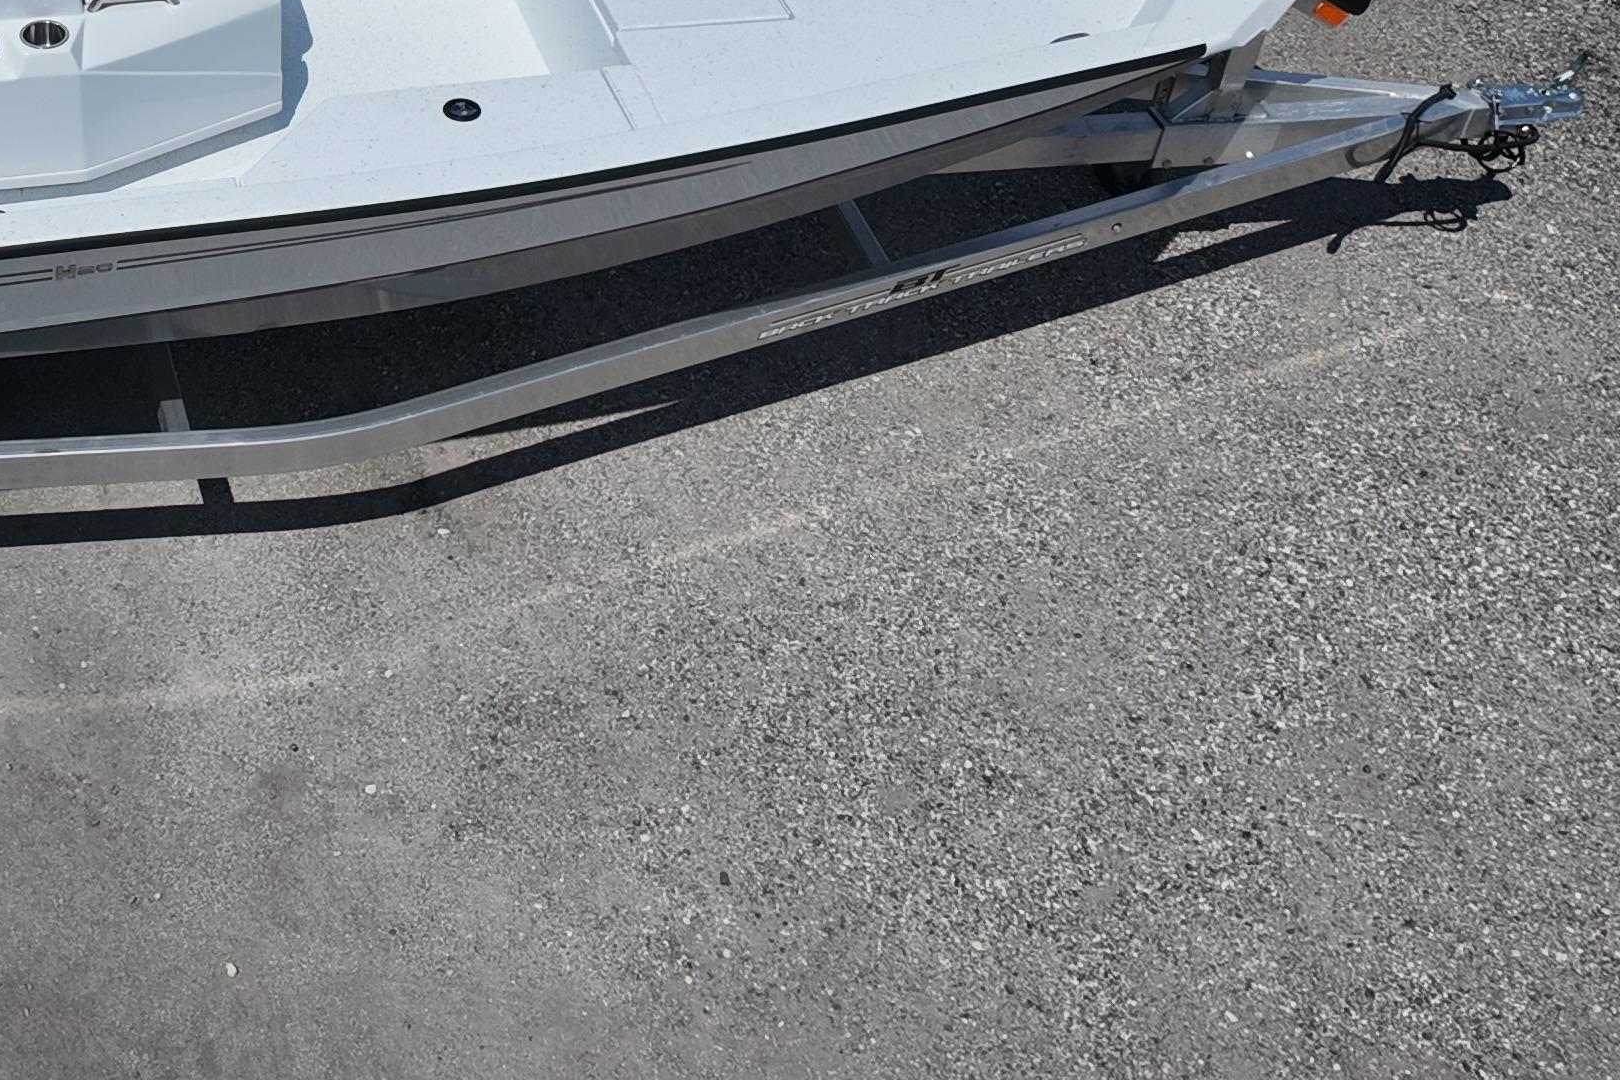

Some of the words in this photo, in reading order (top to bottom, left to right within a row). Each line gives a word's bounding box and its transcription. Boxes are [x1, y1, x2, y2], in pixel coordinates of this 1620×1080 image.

[757, 309, 840, 341] BACK
[846, 278, 952, 315] TRACK
[949, 237, 1089, 285] TRAILERS
